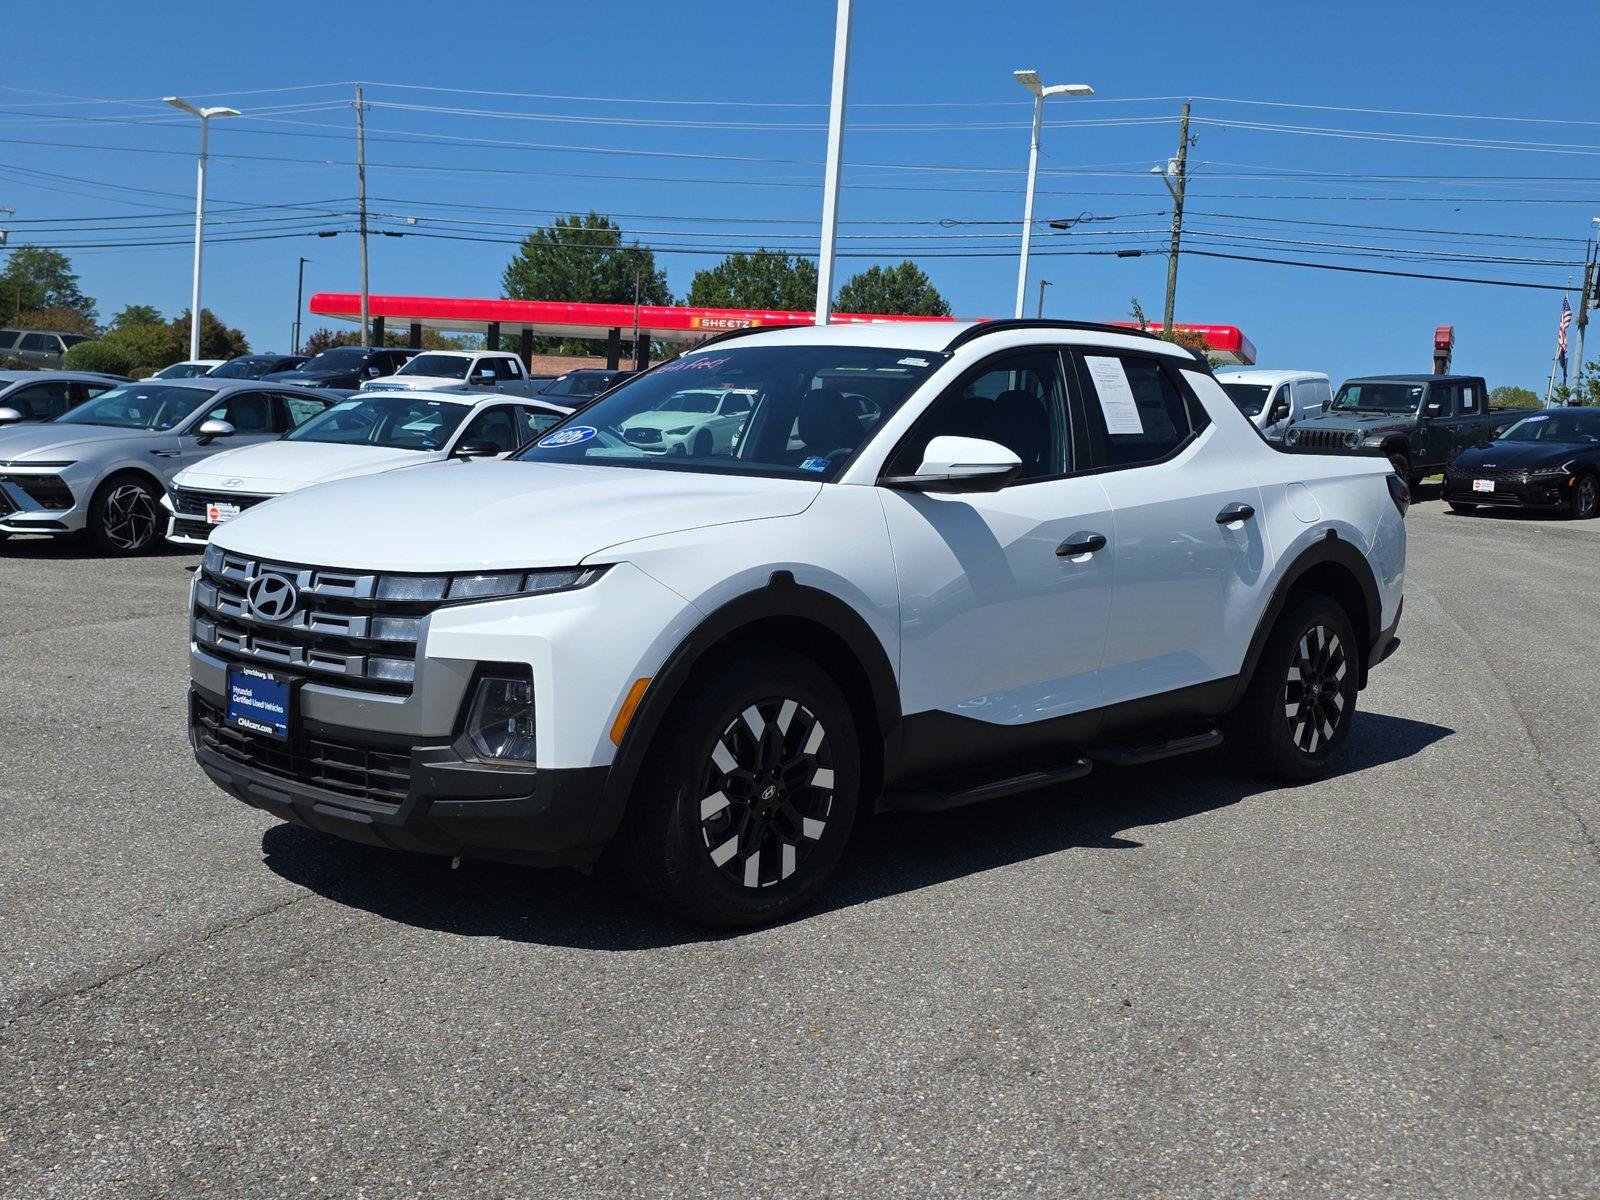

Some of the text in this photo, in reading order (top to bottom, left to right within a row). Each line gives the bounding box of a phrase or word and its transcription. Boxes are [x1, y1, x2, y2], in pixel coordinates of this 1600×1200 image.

[702, 319, 750, 329] SHEETZ
[232, 685, 253, 697] Hyundai
[232, 694, 284, 714] Certified Used Vehicles
